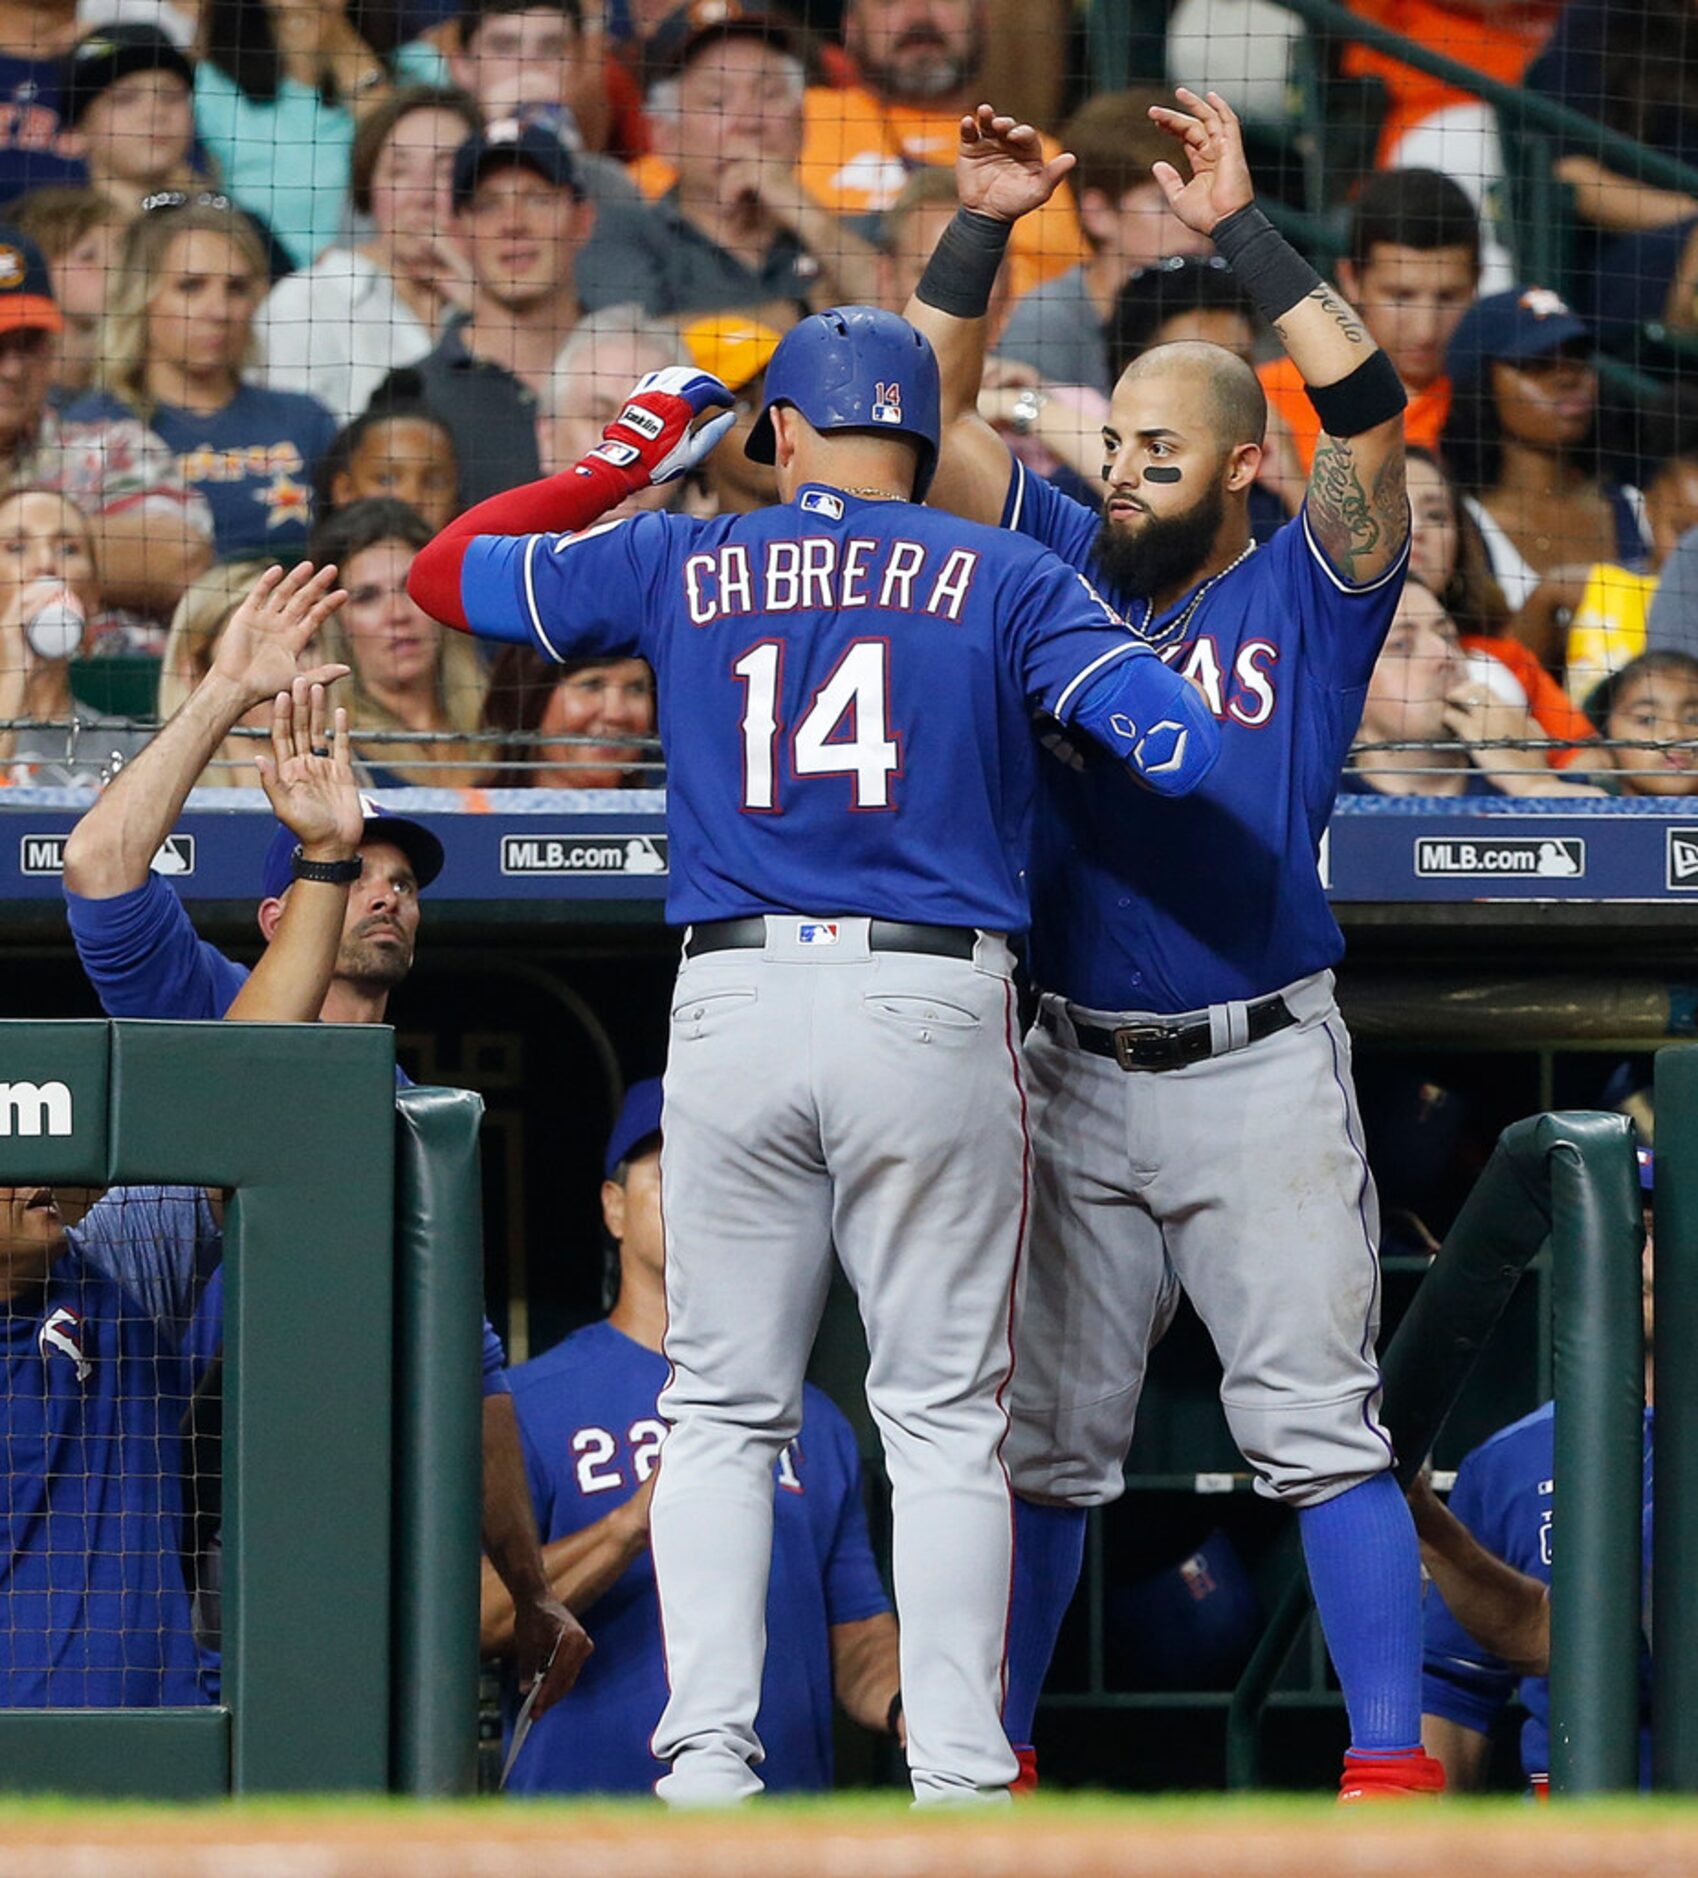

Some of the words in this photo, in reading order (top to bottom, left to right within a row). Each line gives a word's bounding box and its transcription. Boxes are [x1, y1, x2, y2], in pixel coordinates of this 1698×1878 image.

[875, 381, 901, 406] 14
[684, 535, 981, 628] CABRERA
[1158, 634, 1280, 729] AS
[730, 636, 904, 816] 14
[508, 842, 622, 868] MLB.com
[1421, 845, 1536, 870] MLB.com
[571, 1417, 671, 1496] 22
